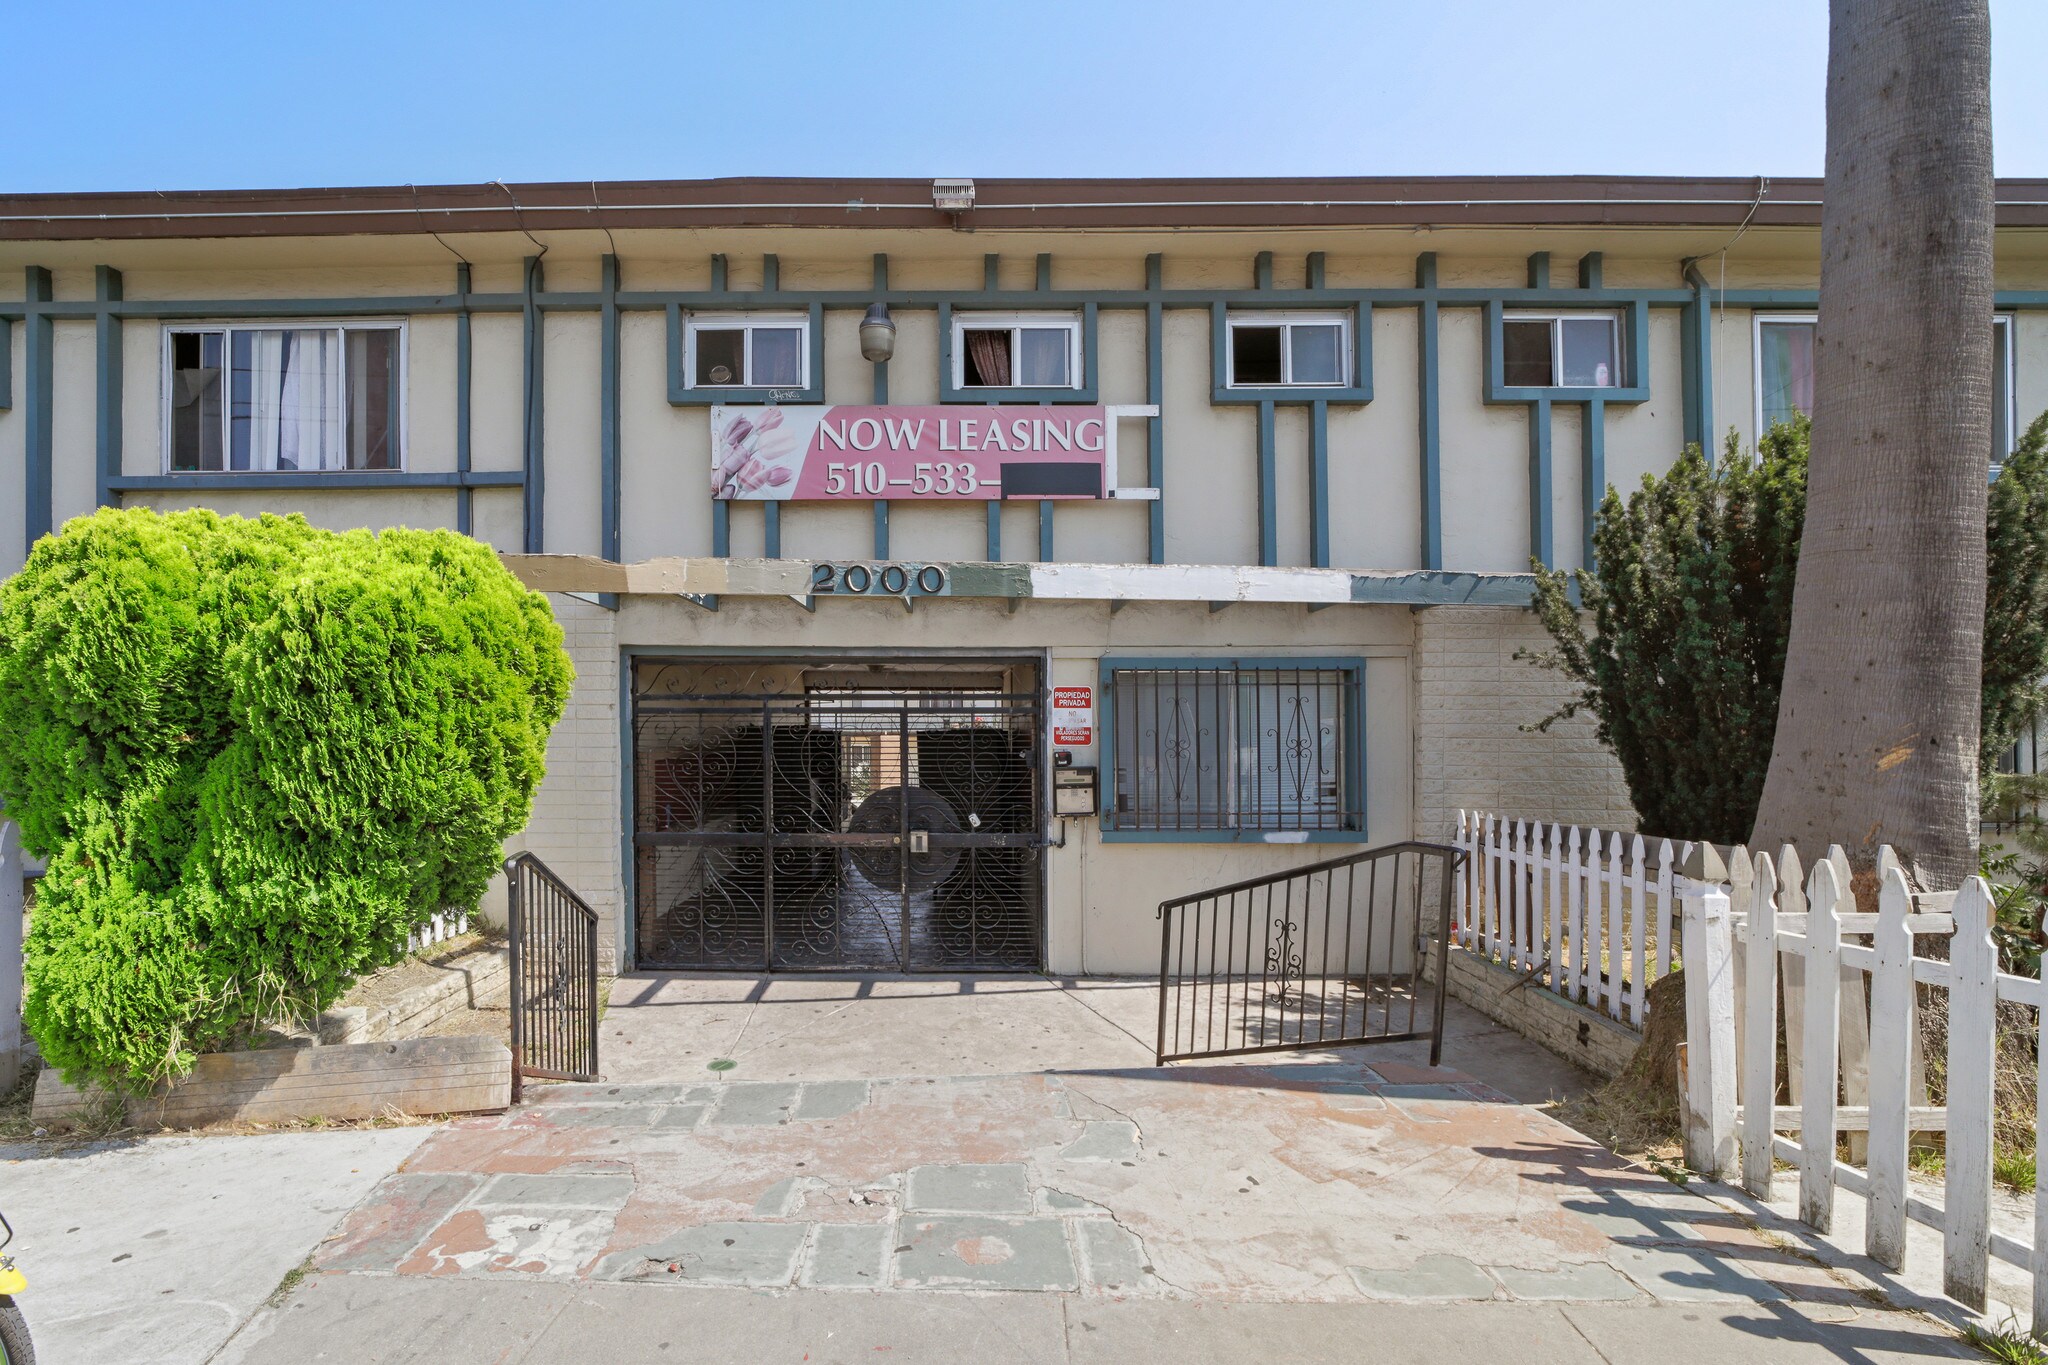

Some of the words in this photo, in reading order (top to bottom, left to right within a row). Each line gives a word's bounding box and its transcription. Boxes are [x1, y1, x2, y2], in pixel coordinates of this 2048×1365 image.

[818, 419, 926, 452] NOW
[938, 419, 1105, 452] LEASING
[811, 564, 945, 593] 2000
